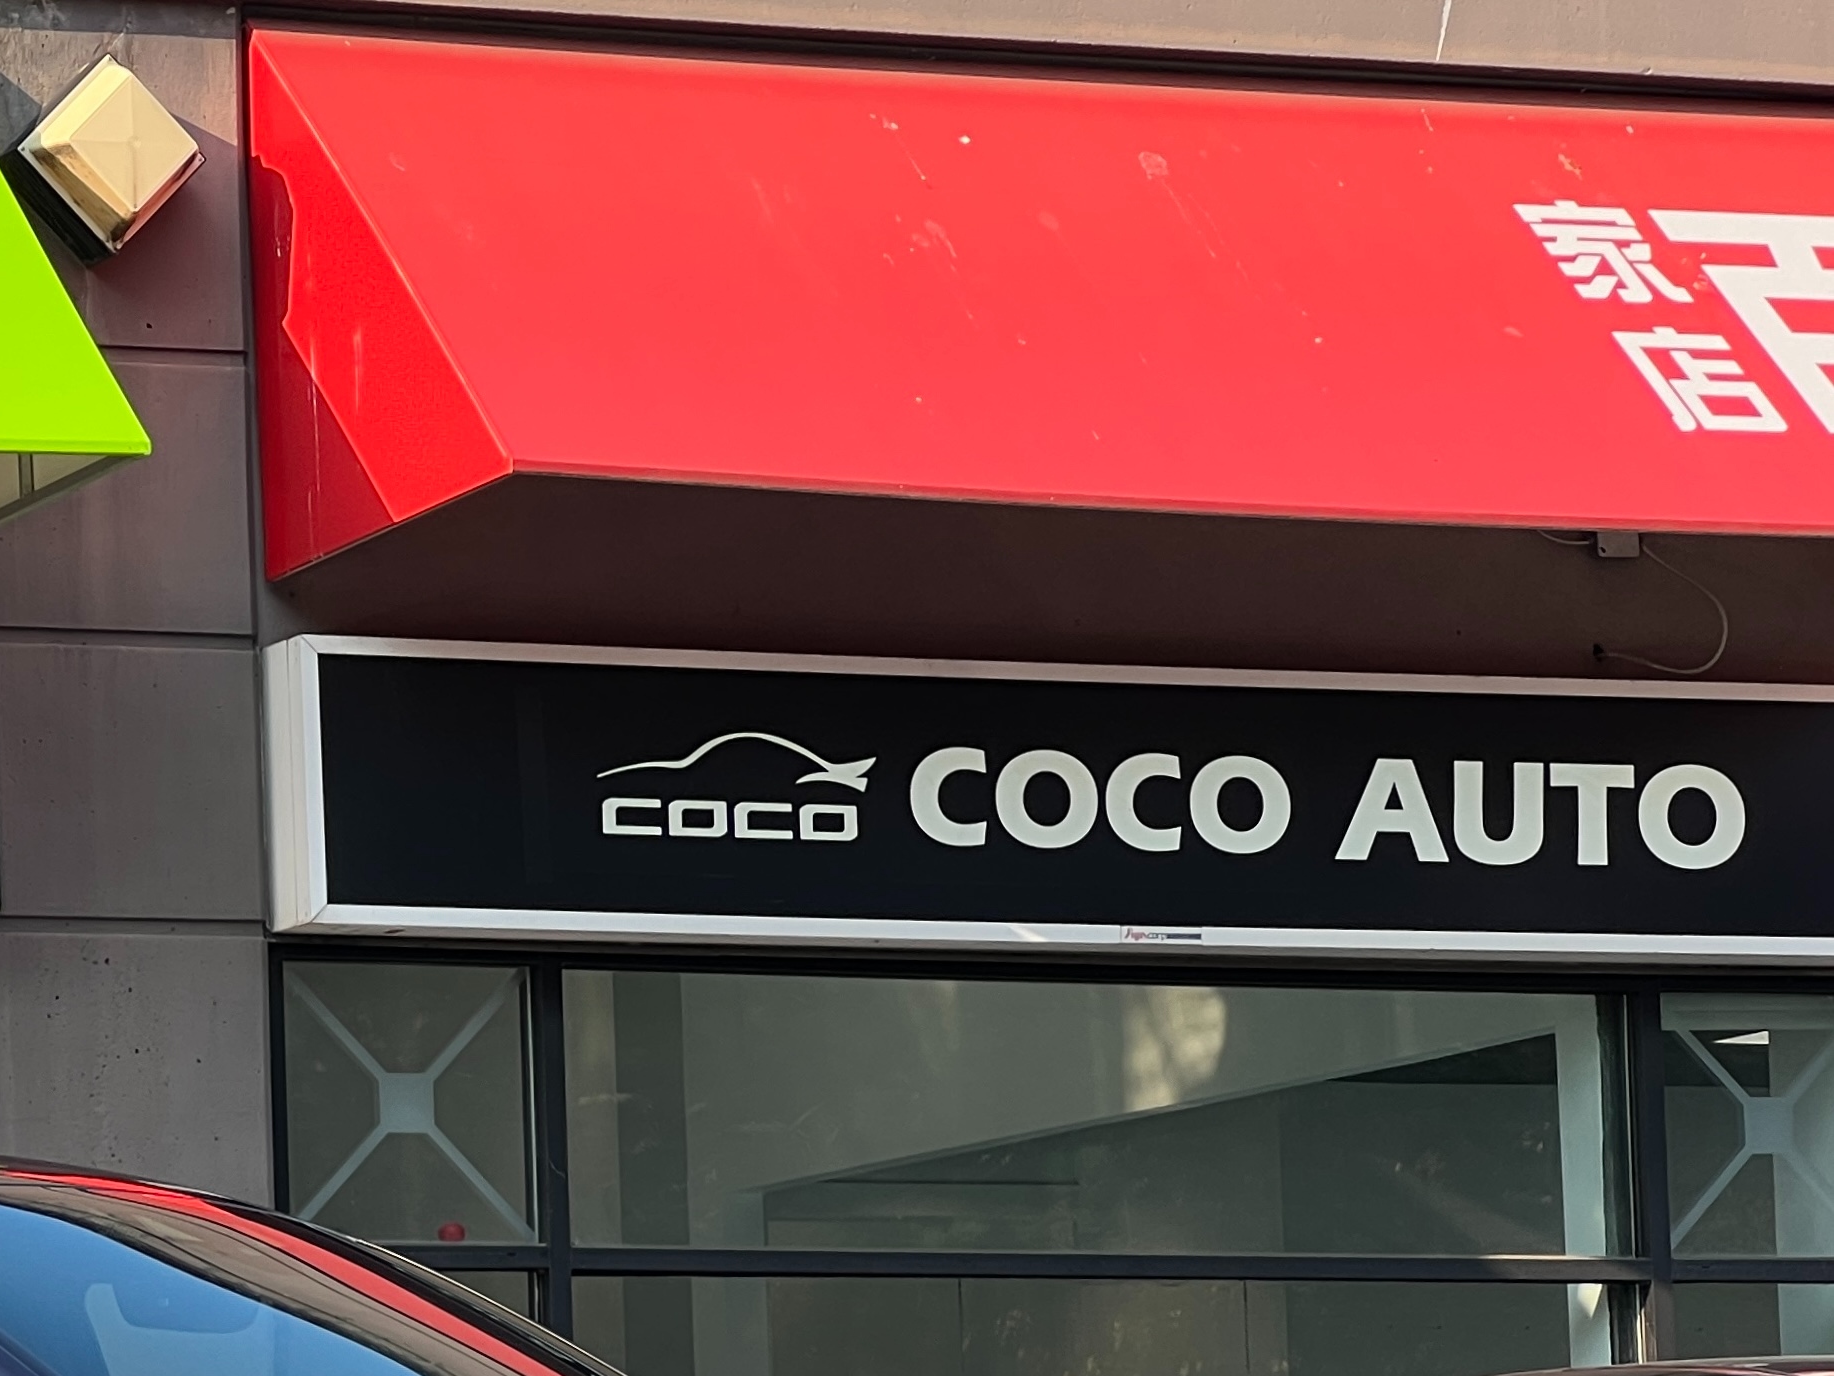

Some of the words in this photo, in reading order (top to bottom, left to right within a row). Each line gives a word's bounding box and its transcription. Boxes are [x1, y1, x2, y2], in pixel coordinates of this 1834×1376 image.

[600, 796, 860, 843] COCO
[908, 745, 1293, 855] COCO
[1333, 757, 1747, 871] AUTO
